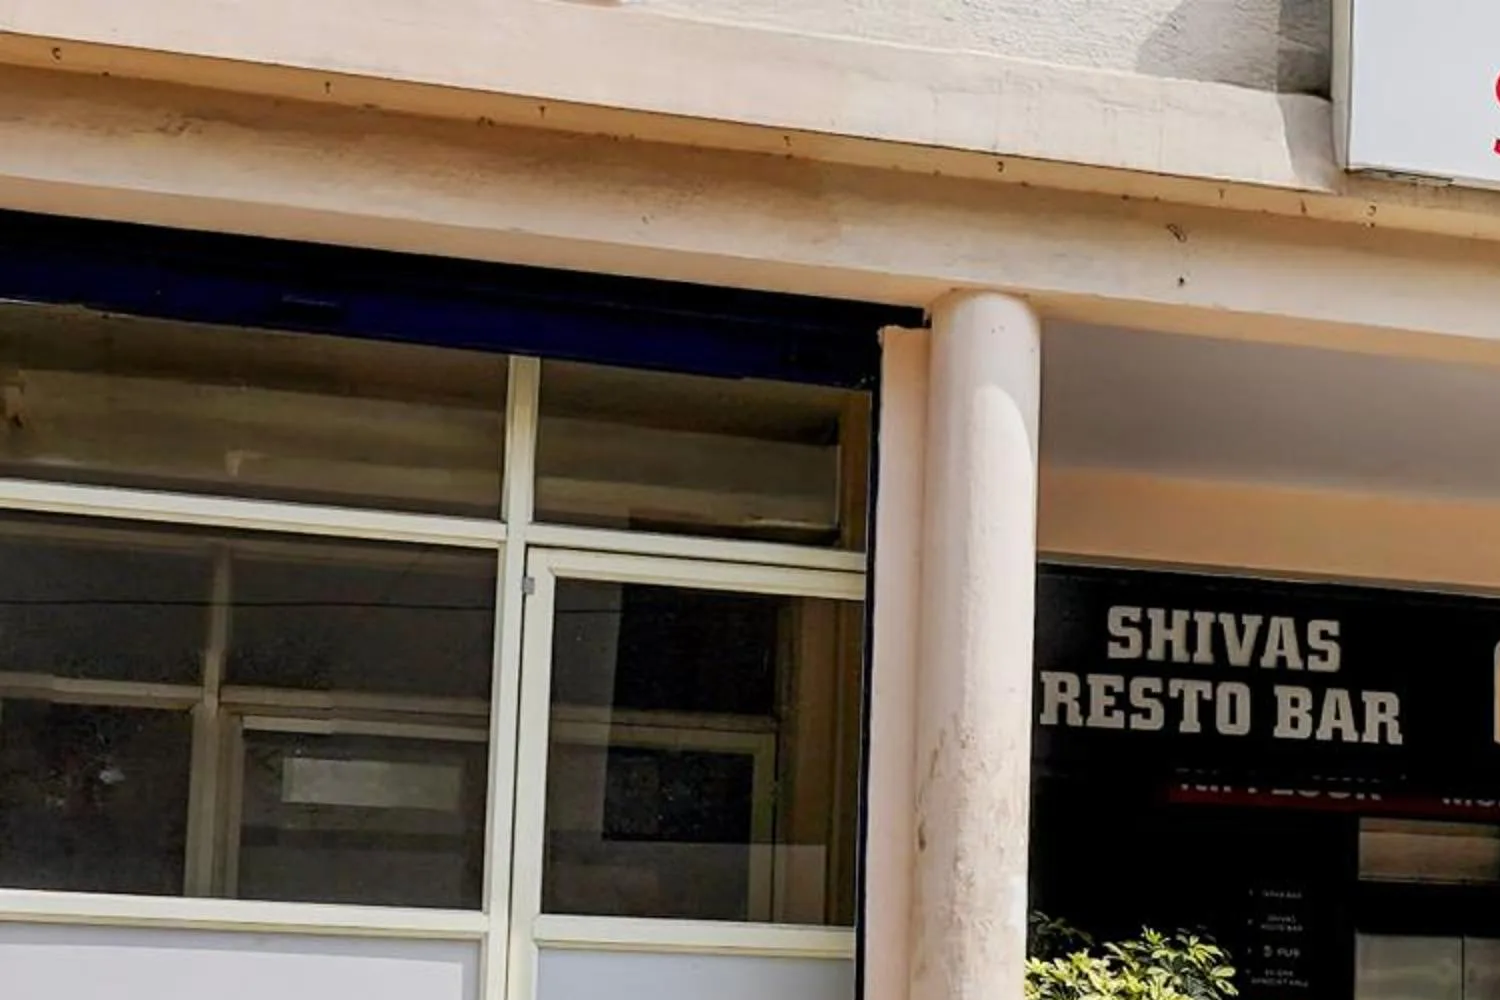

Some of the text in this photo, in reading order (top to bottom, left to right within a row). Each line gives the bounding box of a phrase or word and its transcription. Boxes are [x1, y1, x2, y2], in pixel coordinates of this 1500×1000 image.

[1107, 605, 1341, 672] SHIVAS
[1039, 671, 1403, 745] RESTO BAR
